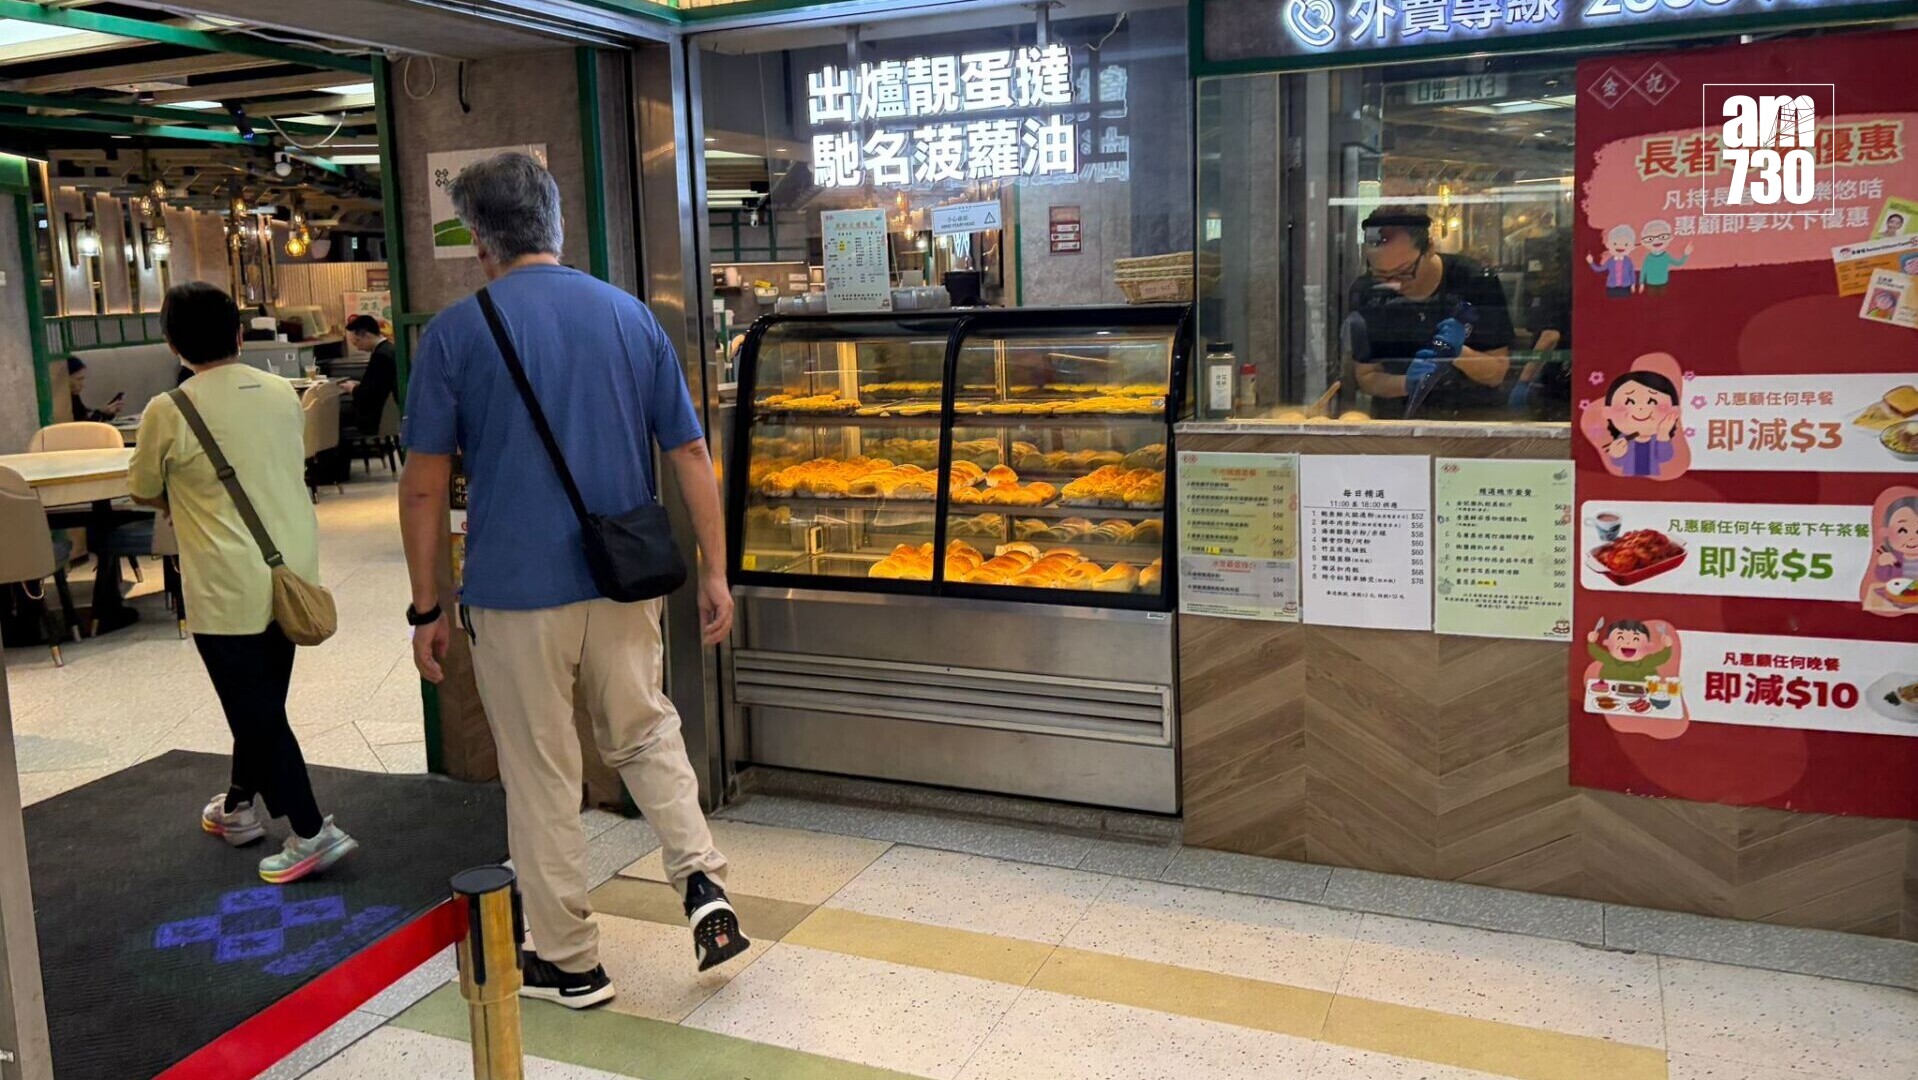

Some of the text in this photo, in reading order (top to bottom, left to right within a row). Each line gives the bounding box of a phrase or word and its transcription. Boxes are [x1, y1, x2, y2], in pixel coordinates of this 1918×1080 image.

[1349, 0, 1560, 40] 外賣專線
[807, 43, 1073, 126] 出爐靚蛋撻
[811, 114, 1078, 189] 馳名菠蘿油
[1639, 122, 1901, 176] 長者優惠
[1674, 206, 1870, 236] 惠顧即享以下優惠
[1714, 391, 1834, 407] 凡惠顧任何早餐
[1706, 418, 1843, 453] 即減$3
[1668, 518, 1871, 539] 凡惠顧任何午餐或下午茶餐
[1698, 546, 1834, 583] 即減$5
[1723, 652, 1840, 672] 凡惠顧任何晚餐
[1704, 672, 1859, 710] 即減$10
